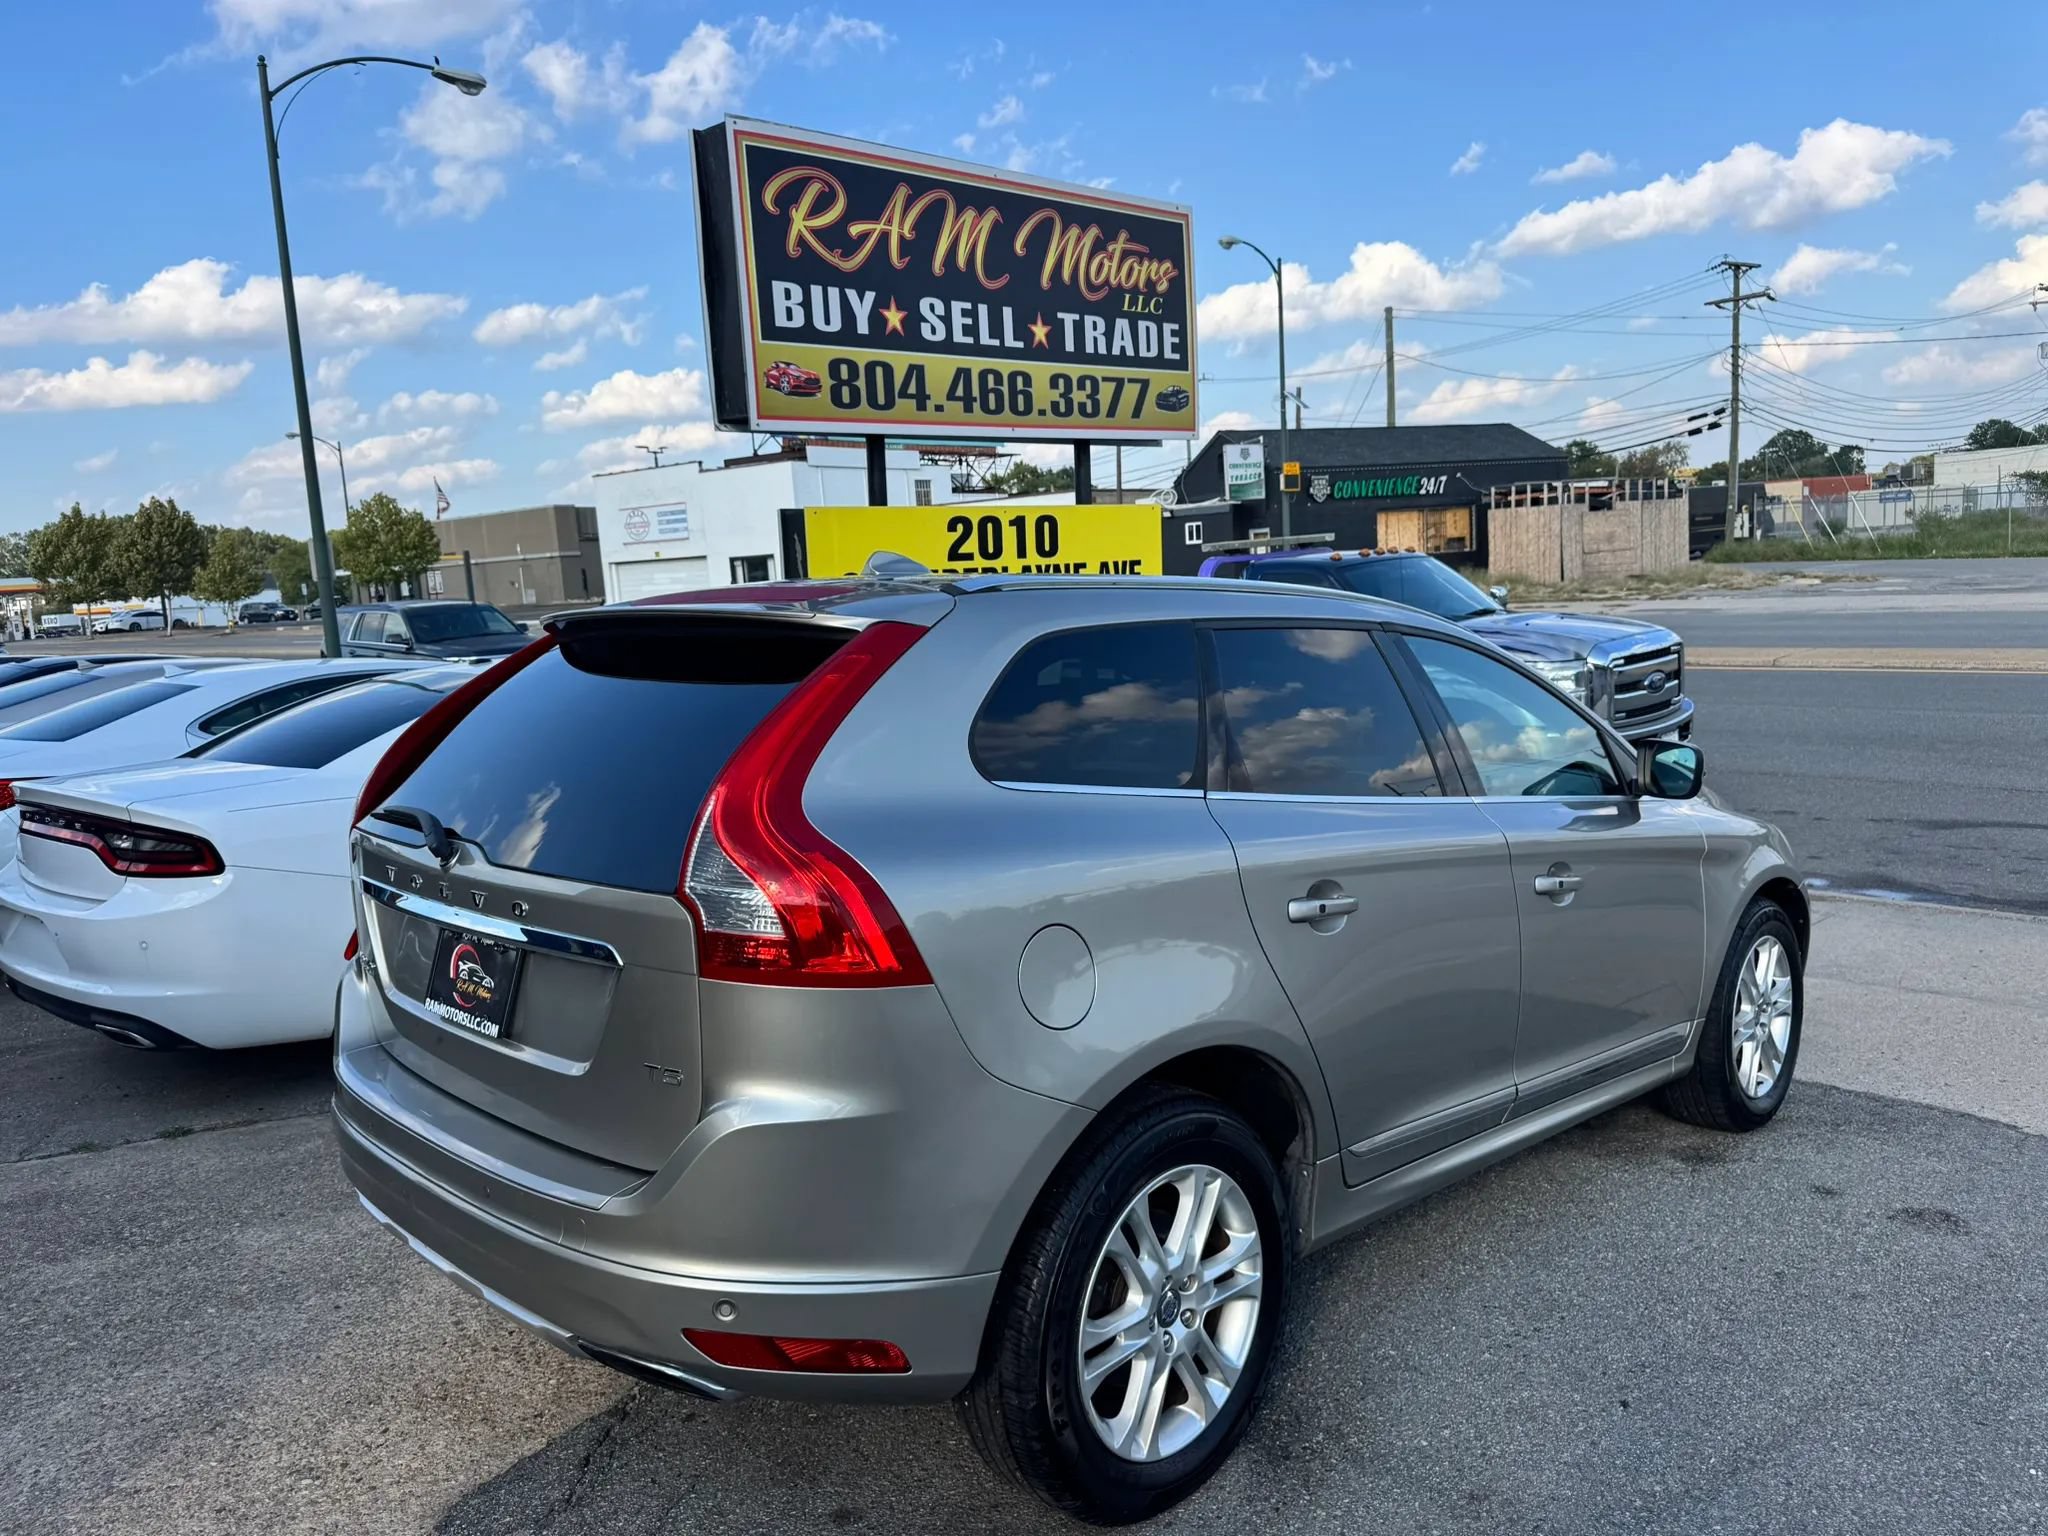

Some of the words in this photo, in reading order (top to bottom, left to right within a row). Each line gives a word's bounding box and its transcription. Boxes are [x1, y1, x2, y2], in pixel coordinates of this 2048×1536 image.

[761, 165, 1010, 290] RAM
[1013, 208, 1179, 302] Motors
[771, 279, 877, 335] BUY
[918, 296, 1025, 349] SELL
[1057, 311, 1182, 361] TRADE
[1121, 293, 1163, 315] LLC
[827, 357, 1150, 420] 804.466.3377
[1333, 476, 1420, 499] CONVENIENCE
[1418, 474, 1448, 495] 24/7
[946, 513, 1059, 562] 2010
[385, 864, 529, 918] VOLVO
[643, 1062, 684, 1087] T5
